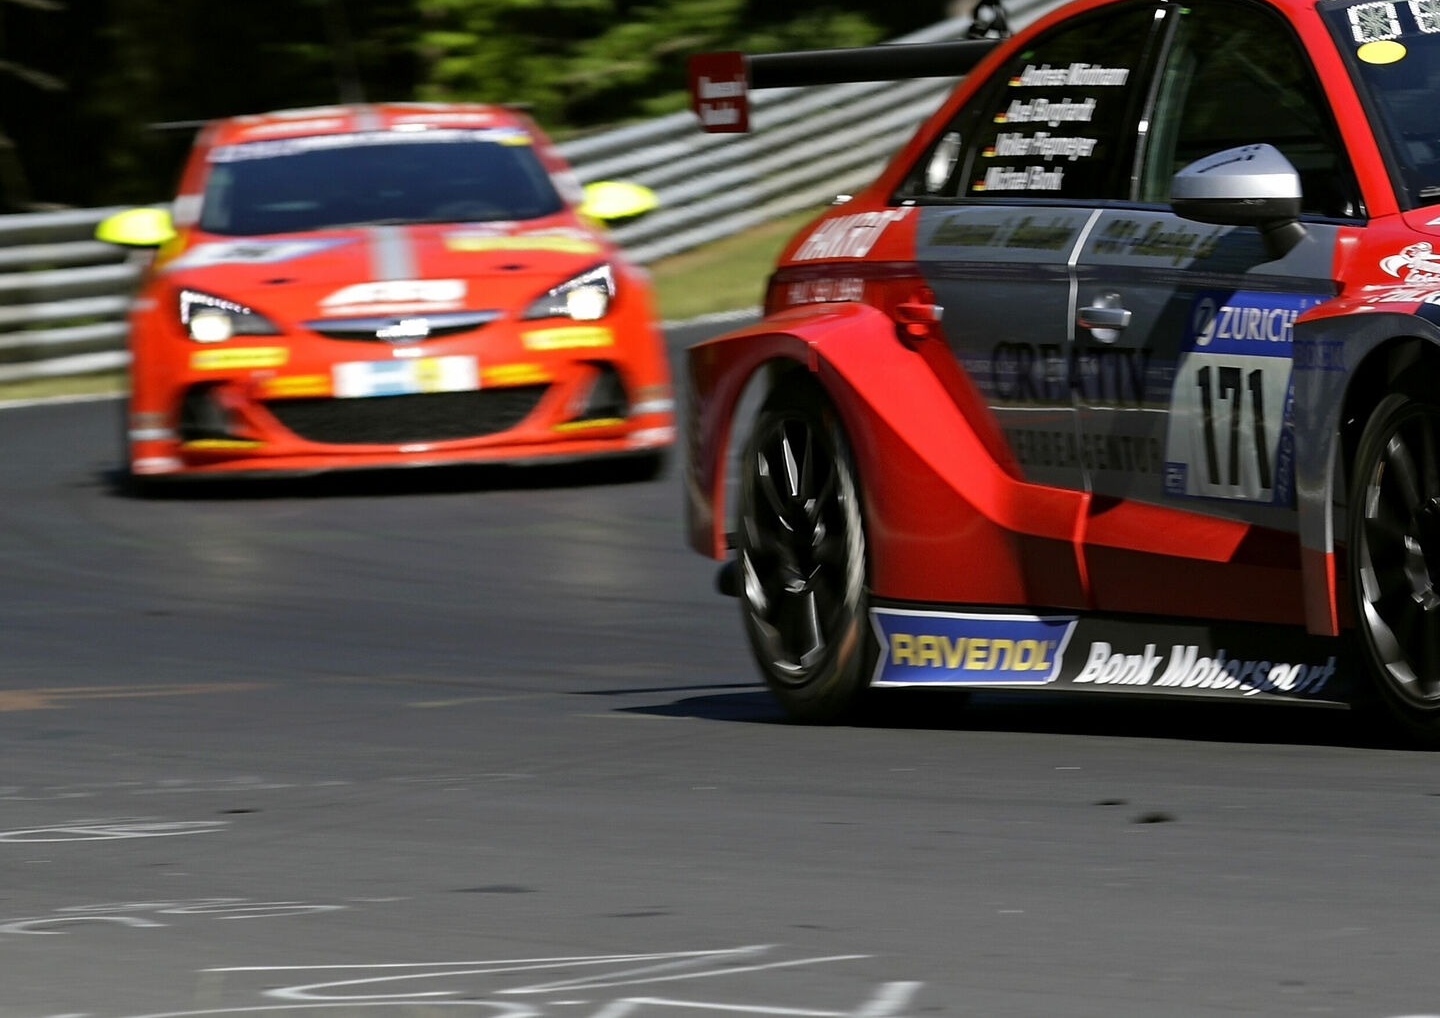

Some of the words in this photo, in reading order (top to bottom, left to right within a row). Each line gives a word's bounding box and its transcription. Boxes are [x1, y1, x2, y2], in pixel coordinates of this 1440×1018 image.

[1216, 305, 1299, 343] ZURICH
[1196, 365, 1273, 490] 171
[890, 633, 1054, 672] RAVENOL
[1072, 641, 1164, 686] Bonk
[1154, 644, 1337, 697] Motorsport
